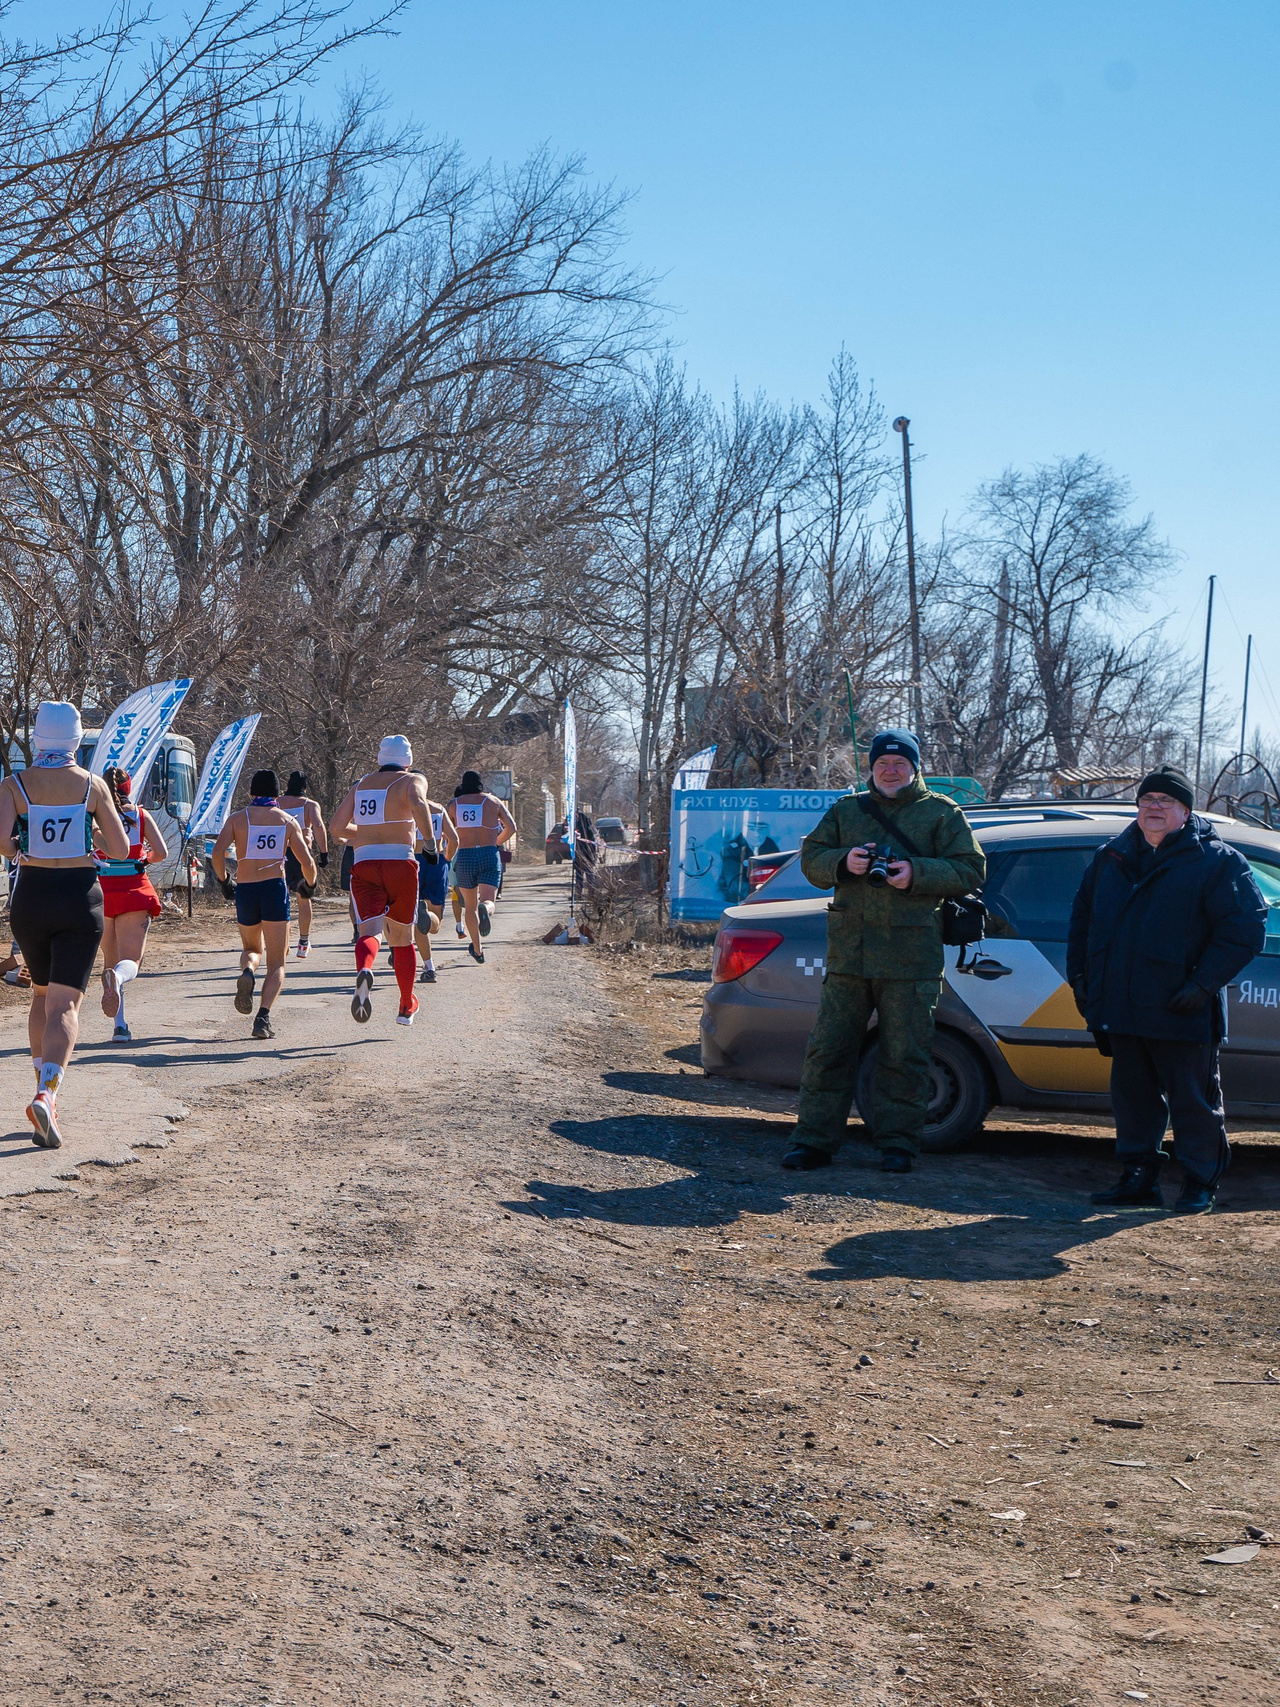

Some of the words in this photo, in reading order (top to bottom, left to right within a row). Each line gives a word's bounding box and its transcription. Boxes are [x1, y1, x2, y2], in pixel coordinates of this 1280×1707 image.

[359, 799, 377, 816] 59
[684, 796, 712, 808] ЯХТ
[720, 796, 759, 809] КЛУБ
[778, 795, 838, 811] ЯКОР
[462, 810, 476, 822] 63
[42, 817, 72, 844] 67
[432, 818, 438, 831] 1
[256, 834, 277, 850] 56
[1238, 980, 1280, 1009] Янд
